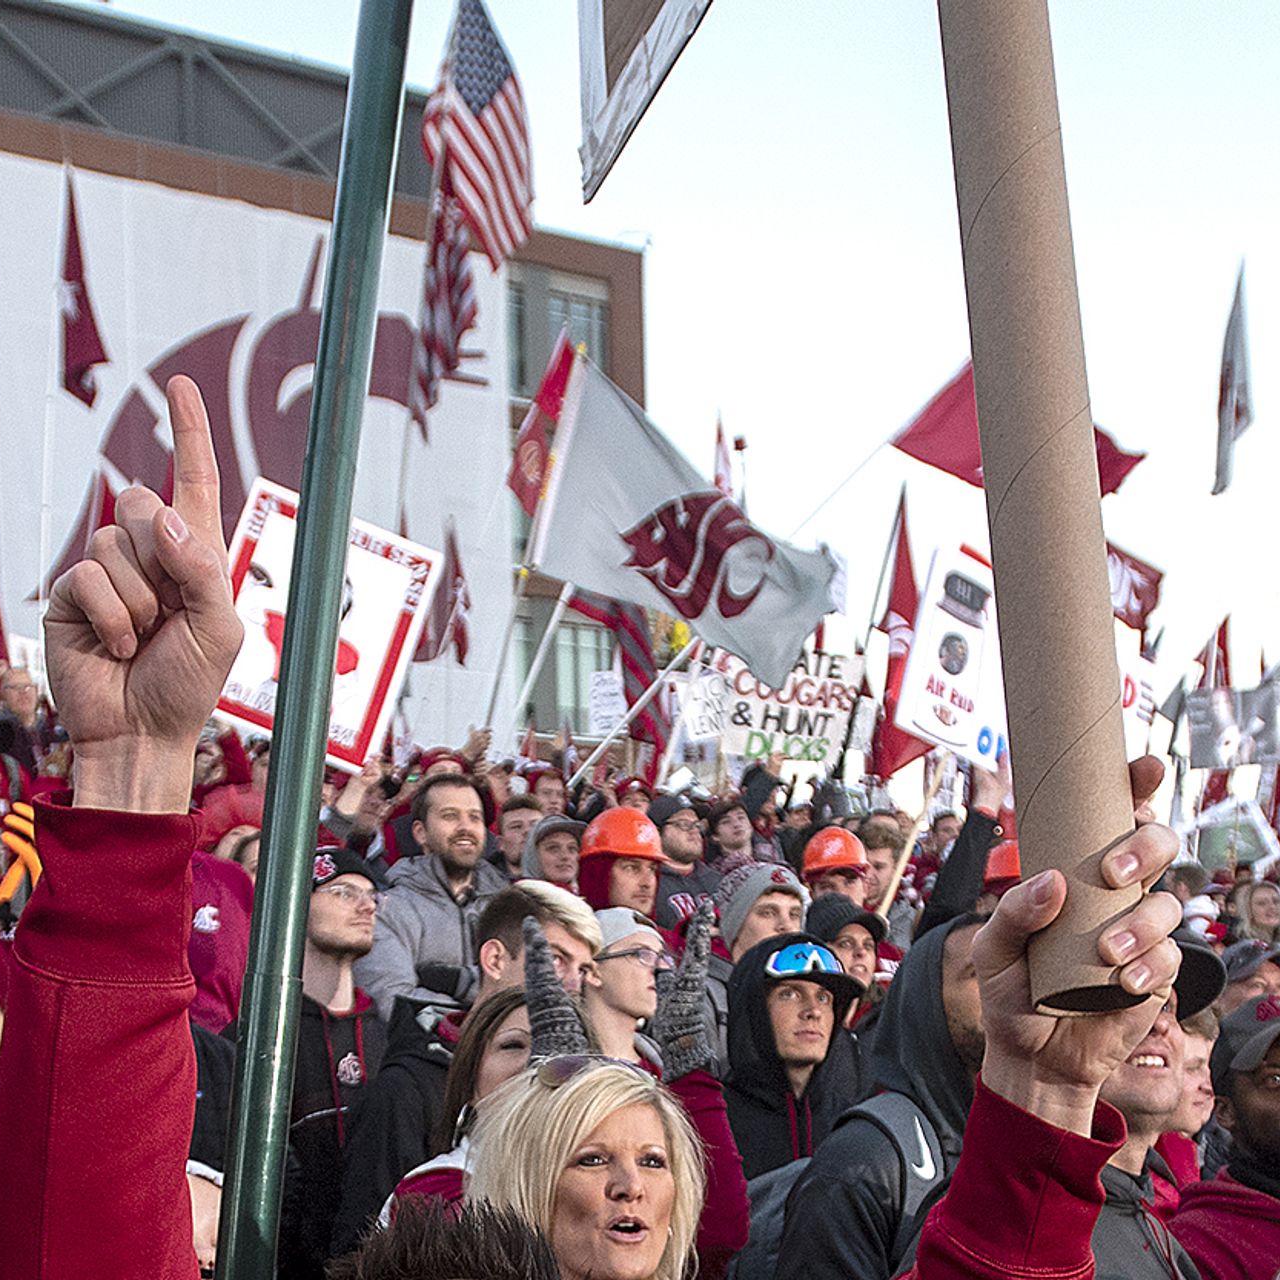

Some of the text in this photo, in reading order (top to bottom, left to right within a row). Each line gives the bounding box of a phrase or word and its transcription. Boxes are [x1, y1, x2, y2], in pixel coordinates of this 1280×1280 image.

[734, 667, 859, 712] COUGARS
[924, 673, 946, 699] AIR
[731, 701, 835, 737] & HUNT
[744, 730, 831, 762] DUCKS
